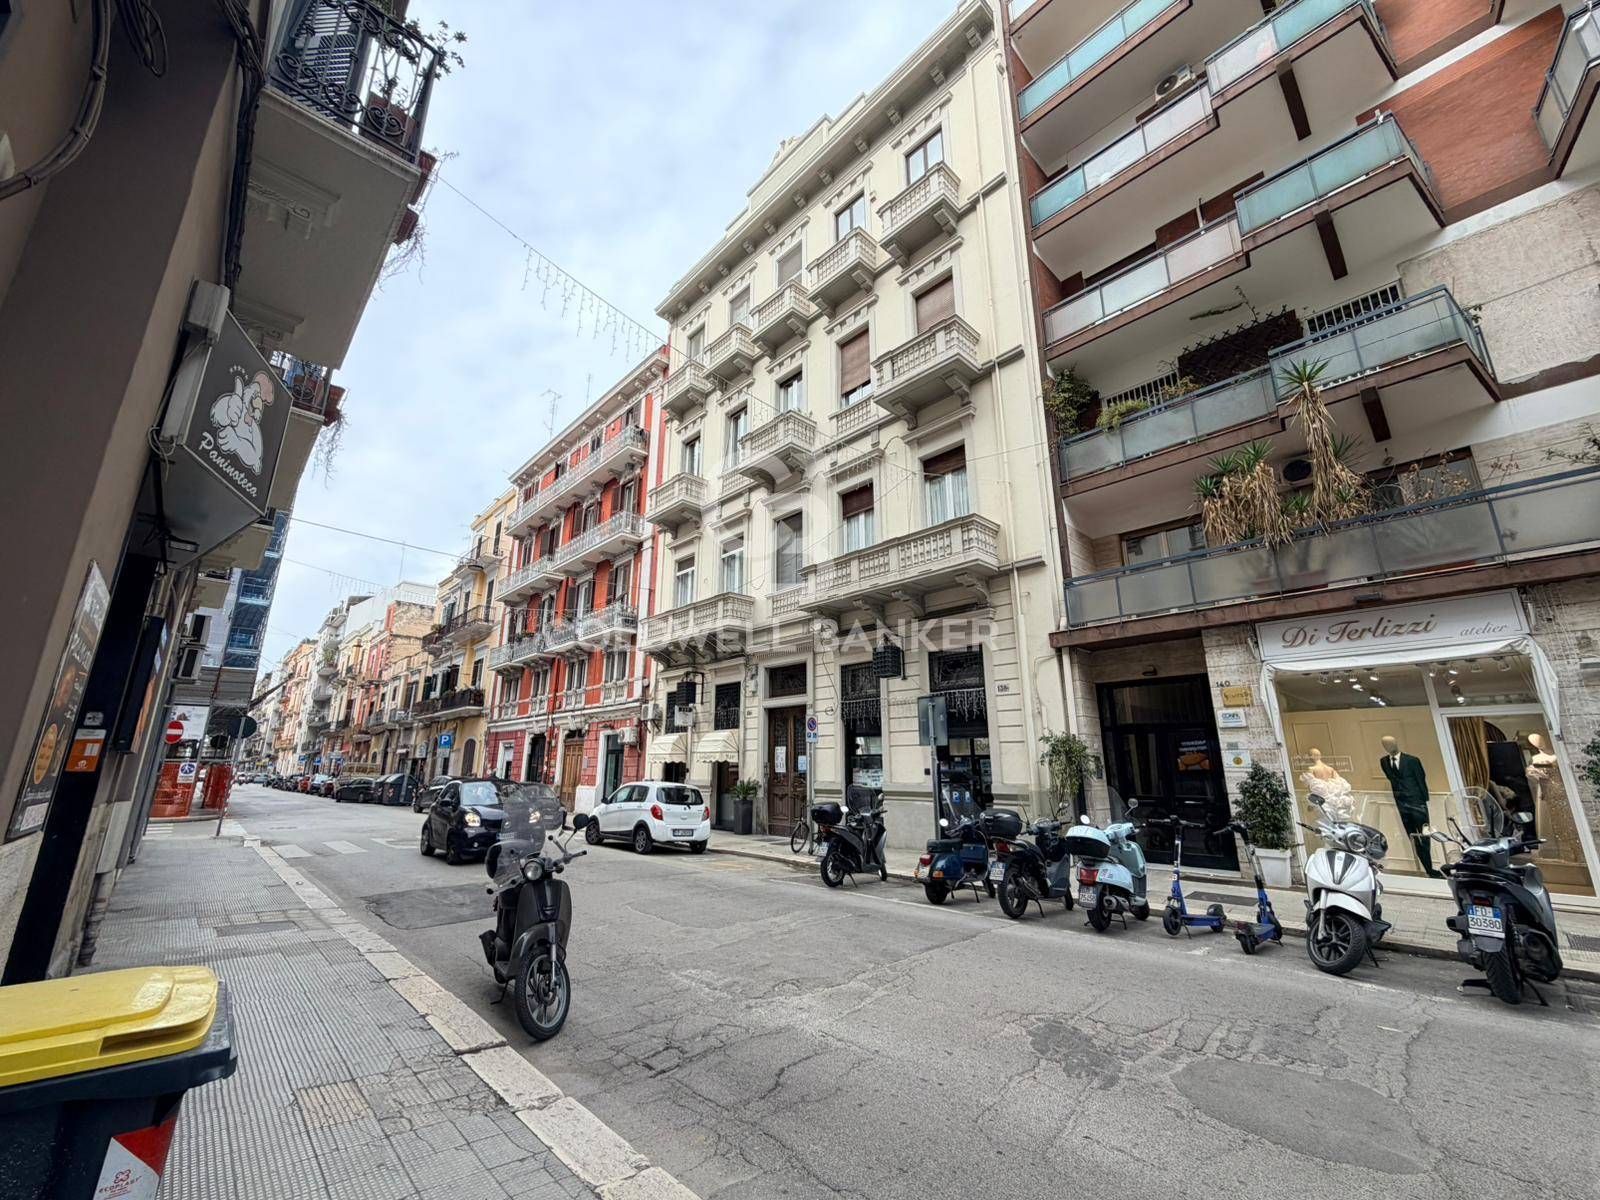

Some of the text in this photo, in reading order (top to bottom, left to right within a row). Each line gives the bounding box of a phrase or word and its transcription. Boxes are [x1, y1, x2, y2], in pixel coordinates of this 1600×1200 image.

[199, 431, 258, 498] Paninoteca
[1281, 613, 1437, 648] Di Terlizzi
[1459, 621, 1508, 637] atelier
[441, 735, 450, 745] P
[1469, 916, 1501, 930] 30380
